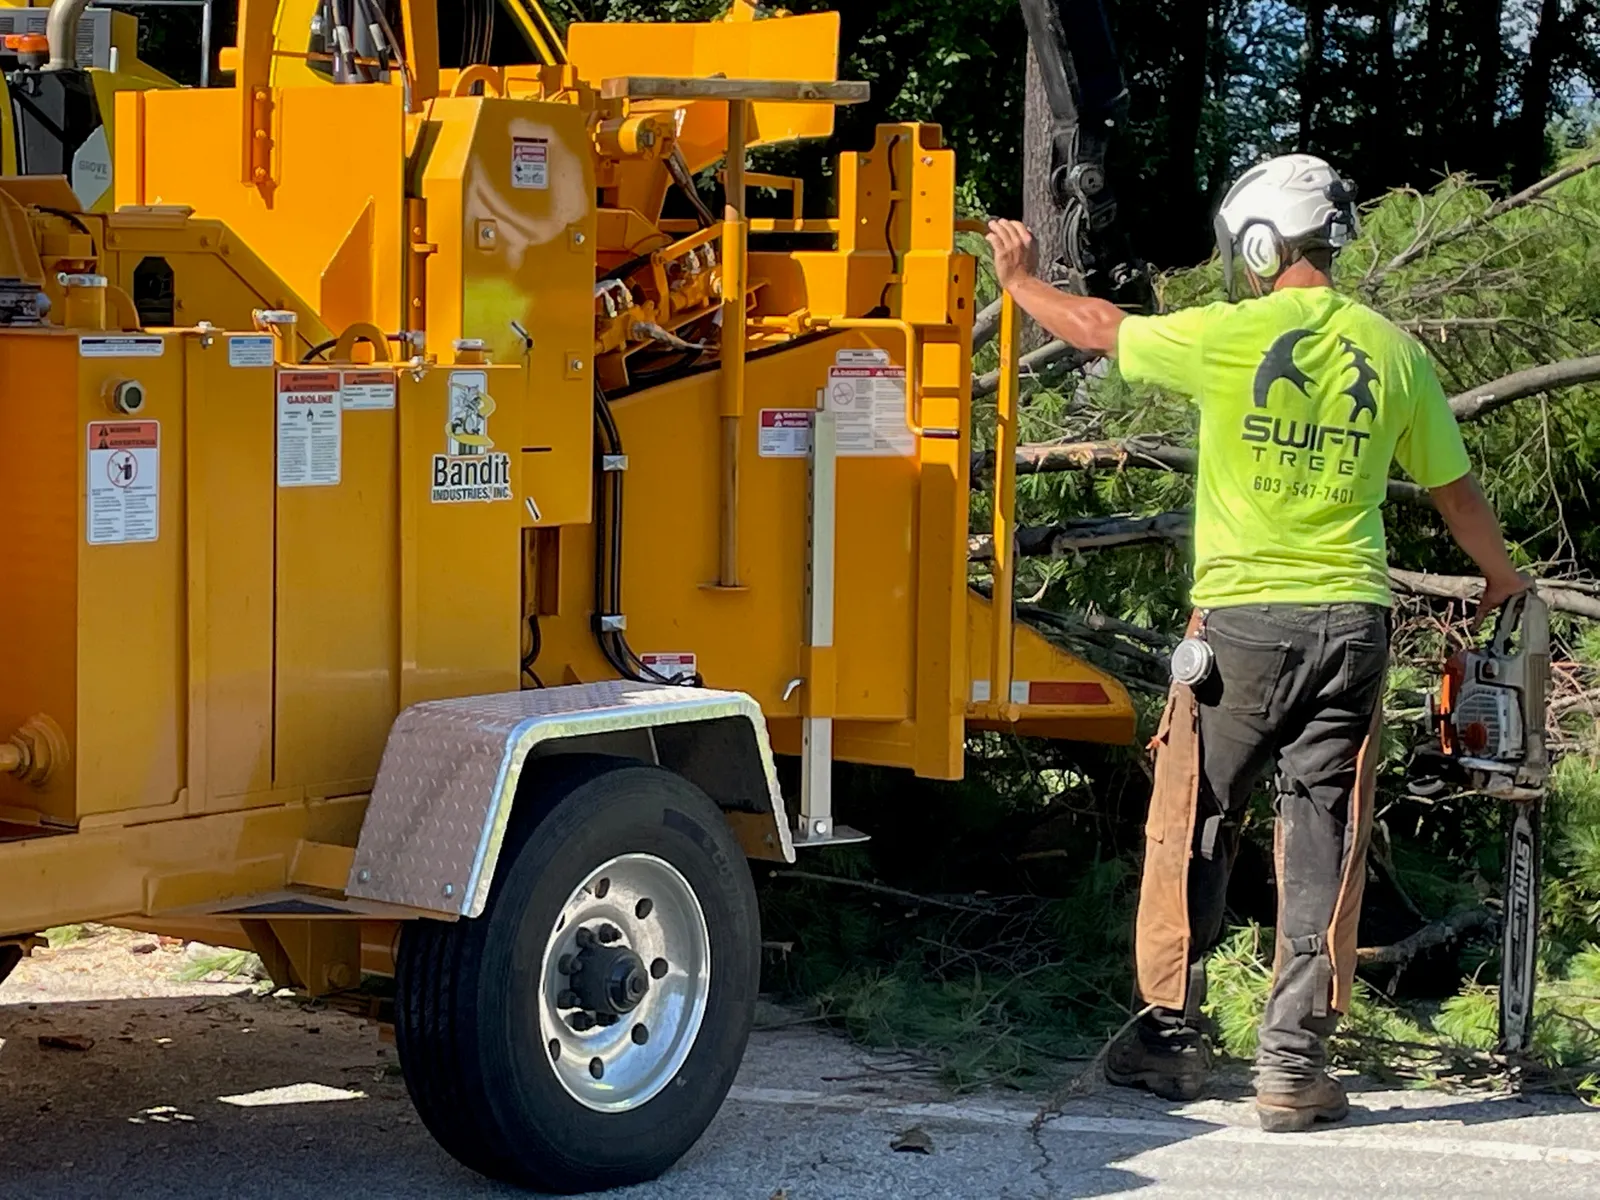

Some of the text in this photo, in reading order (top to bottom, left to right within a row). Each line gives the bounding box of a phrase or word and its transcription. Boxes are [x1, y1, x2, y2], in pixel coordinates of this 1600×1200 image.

[287, 395, 333, 404] GASOLINE
[1242, 414, 1370, 457] SWIFT
[434, 454, 509, 487] Bandit
[1251, 445, 1355, 475] TREE
[1514, 839, 1530, 911] STIHL
